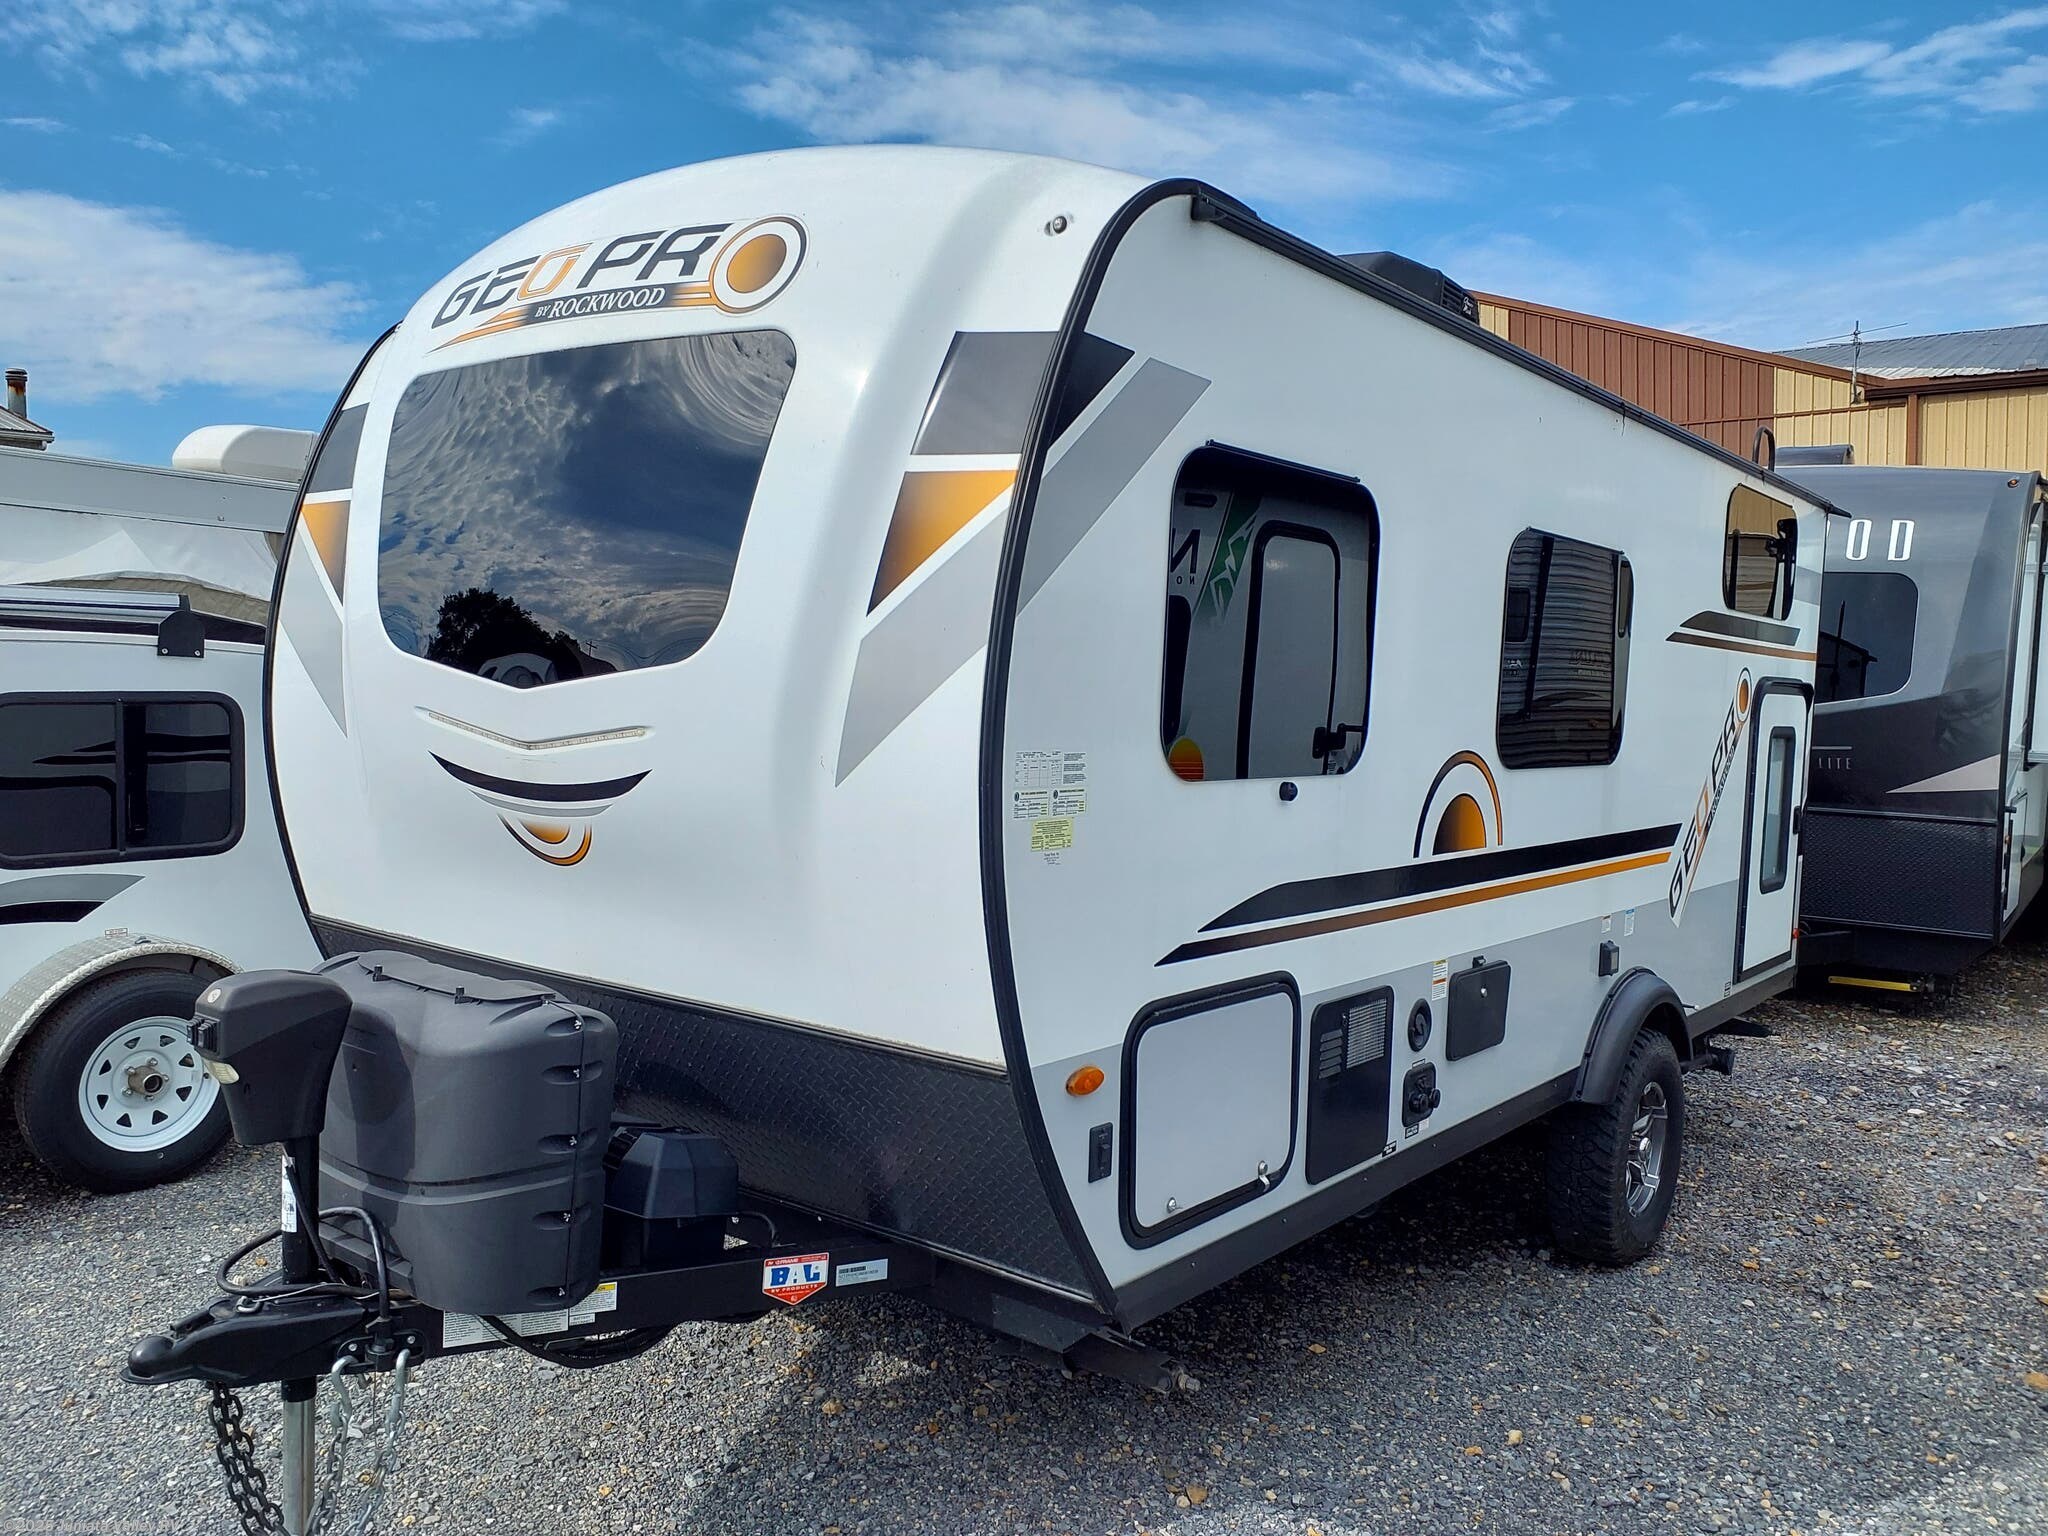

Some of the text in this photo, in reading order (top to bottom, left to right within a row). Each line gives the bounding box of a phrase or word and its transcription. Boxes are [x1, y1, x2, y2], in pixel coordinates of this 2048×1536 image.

[431, 214, 808, 329] GEO PRO
[535, 287, 665, 318] BY ROCKWOOD
[1827, 519, 1915, 562] OD
[1818, 757, 1852, 770] LITE
[770, 1264, 821, 1287] BAL
